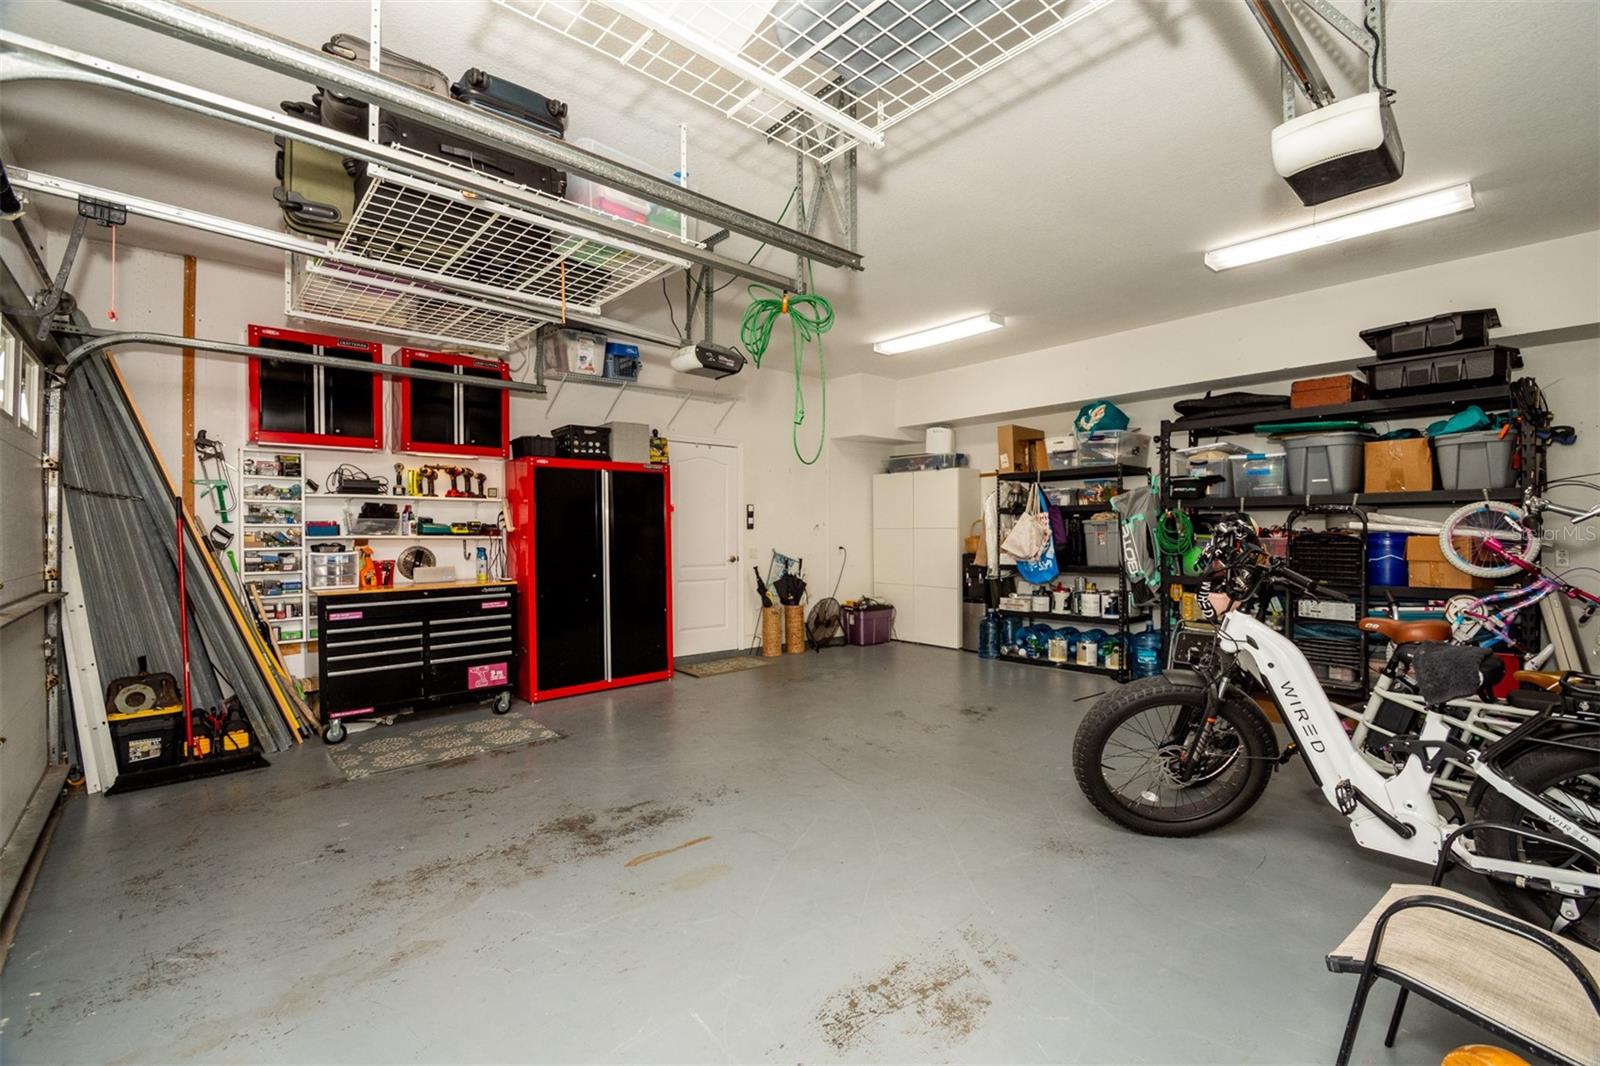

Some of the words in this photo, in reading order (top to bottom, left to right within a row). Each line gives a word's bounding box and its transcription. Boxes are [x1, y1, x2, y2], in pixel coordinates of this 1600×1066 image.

[1197, 581, 1215, 618] WIRED
[1280, 681, 1326, 754] WIRED
[1548, 814, 1590, 844] WIRED
